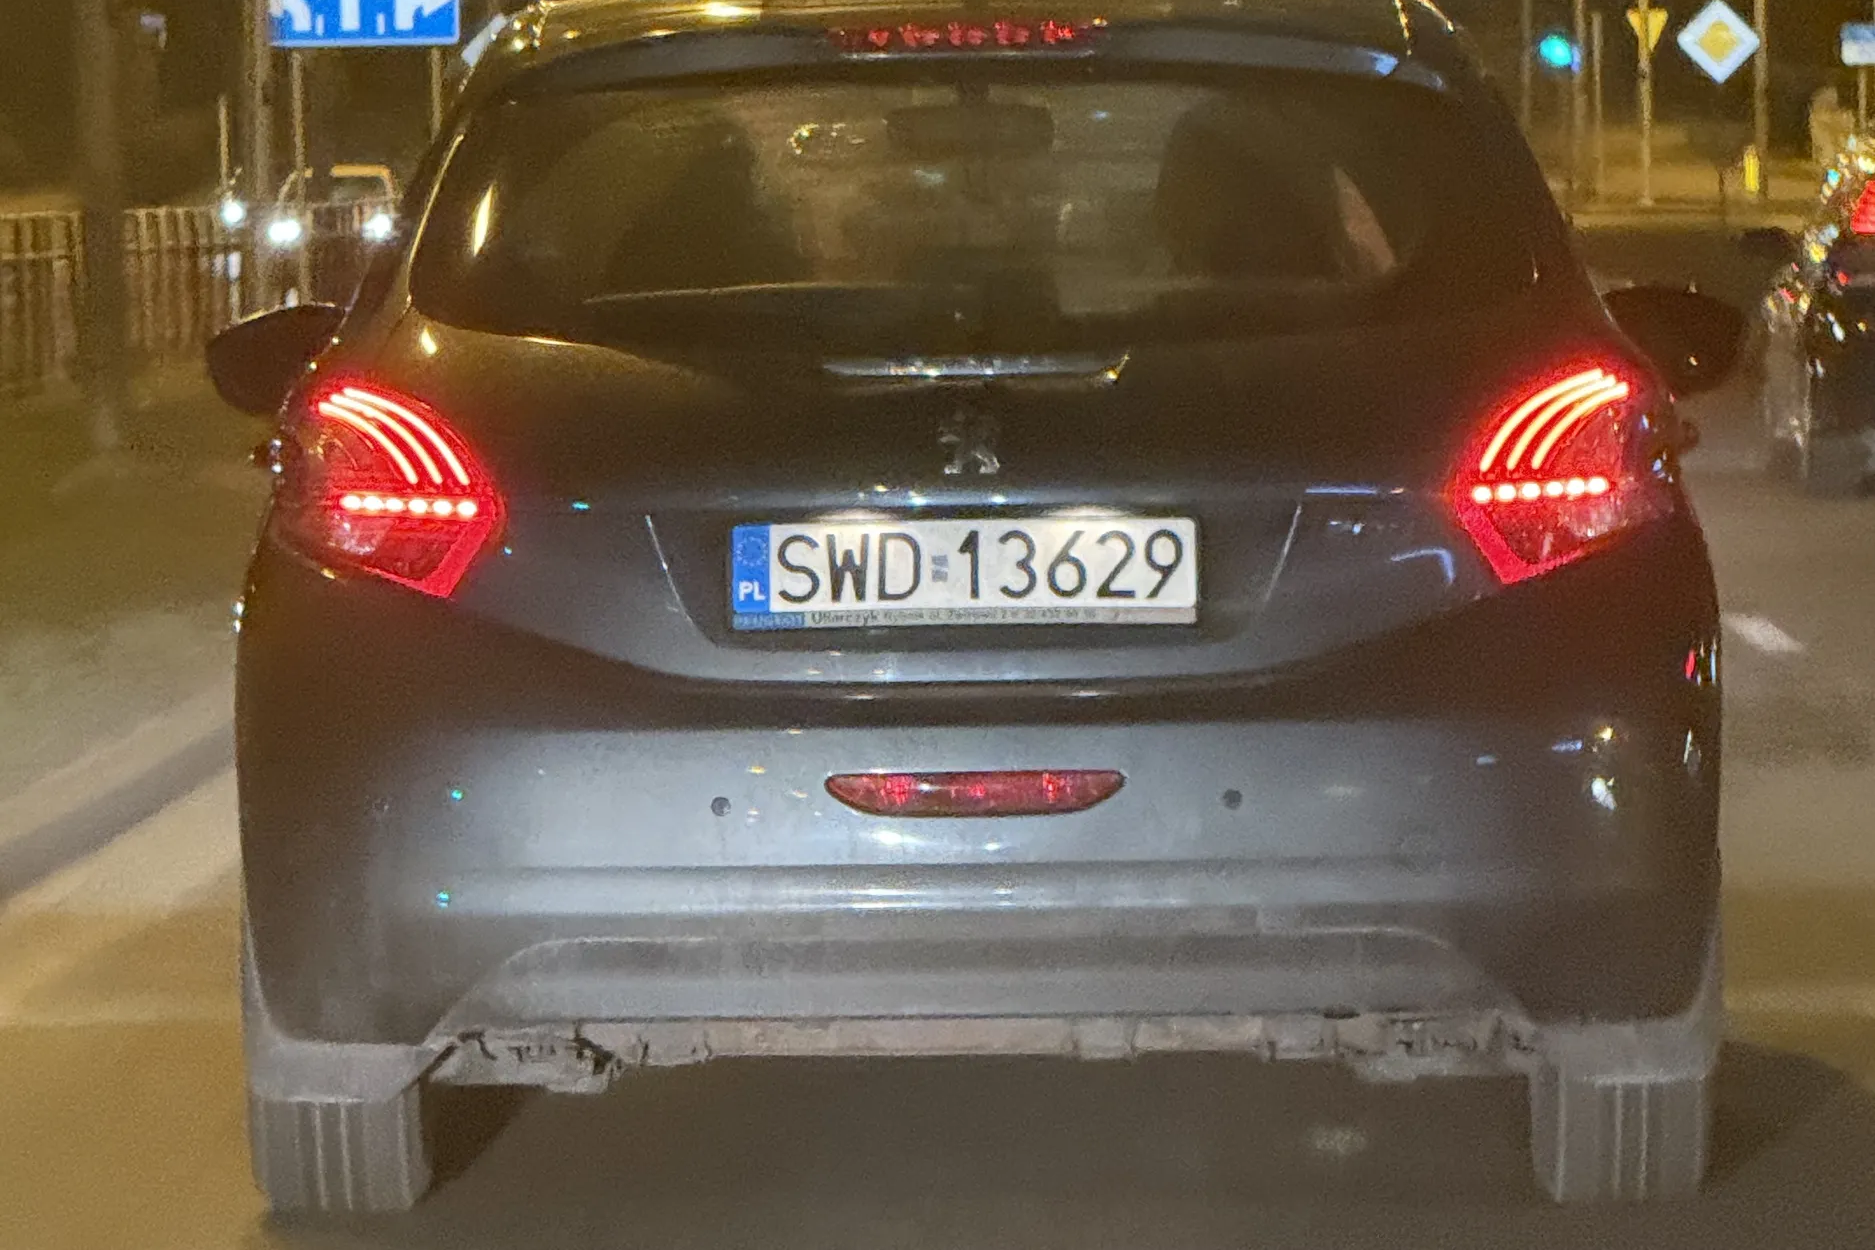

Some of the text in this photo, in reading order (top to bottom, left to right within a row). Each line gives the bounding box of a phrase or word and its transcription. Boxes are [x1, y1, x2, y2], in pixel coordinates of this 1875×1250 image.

[776, 528, 1185, 604] SWD 13629
[738, 581, 766, 603] PL
